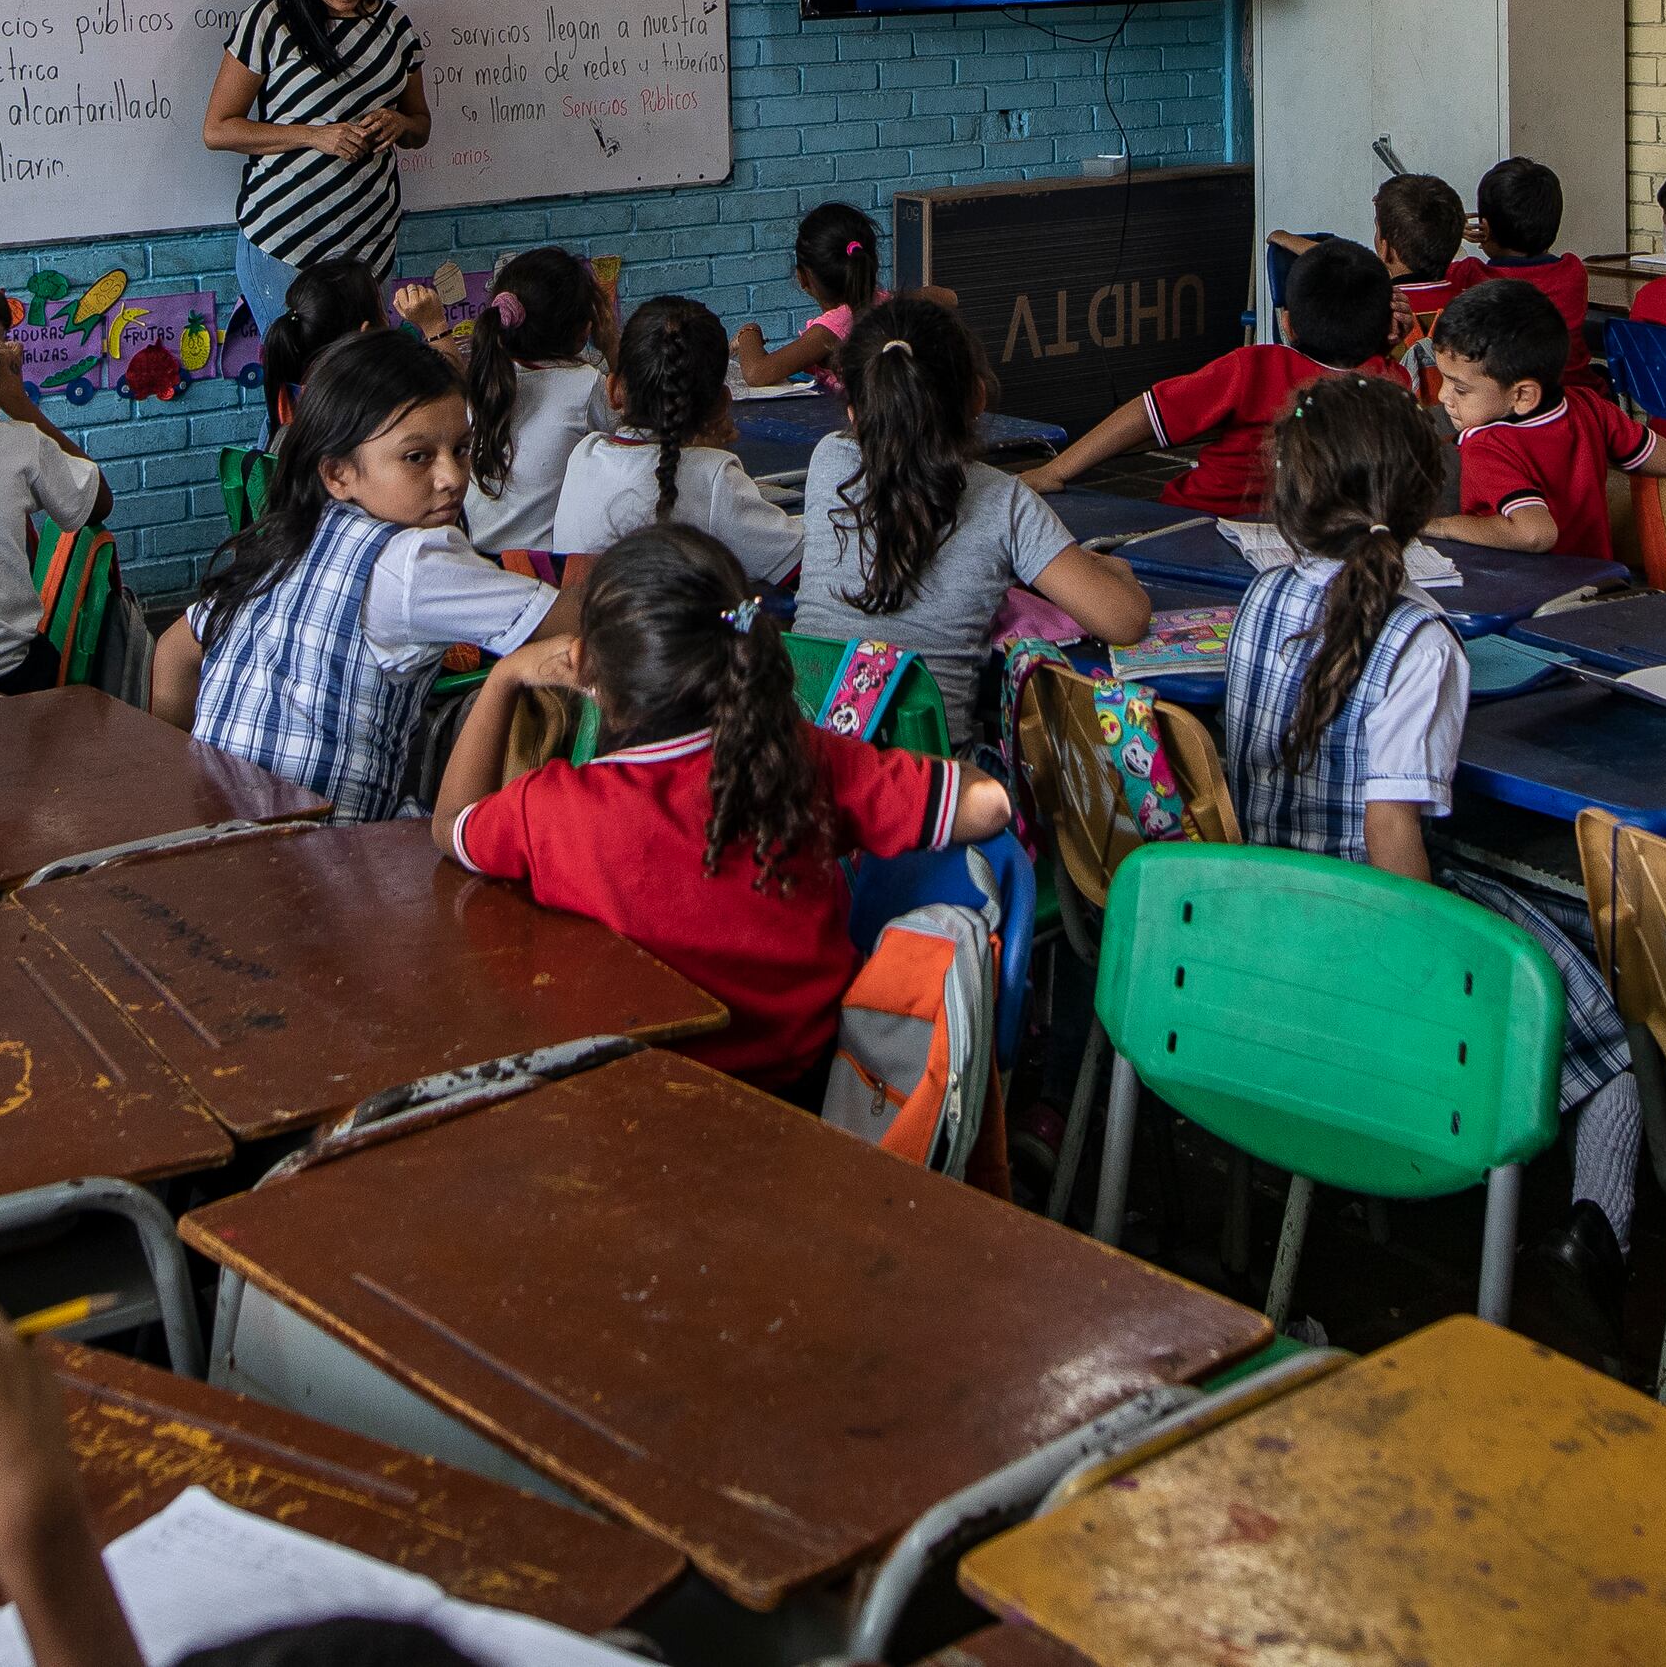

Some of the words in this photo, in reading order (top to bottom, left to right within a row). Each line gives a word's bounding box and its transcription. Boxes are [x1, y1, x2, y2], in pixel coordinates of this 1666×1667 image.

[451, 24, 532, 46] servicios
[546, 6, 600, 60] llegan
[433, 67, 465, 107] por
[475, 54, 529, 85] medio
[545, 50, 570, 83] de
[583, 46, 627, 81] redes
[9, 77, 172, 126] alcantarillado
[490, 96, 546, 123] llaman
[562, 96, 629, 118] Servicios
[5, 324, 66, 343] ERDURAS
[123, 325, 176, 347] FRUTAS
[1000, 274, 1205, 363] UHDTV
